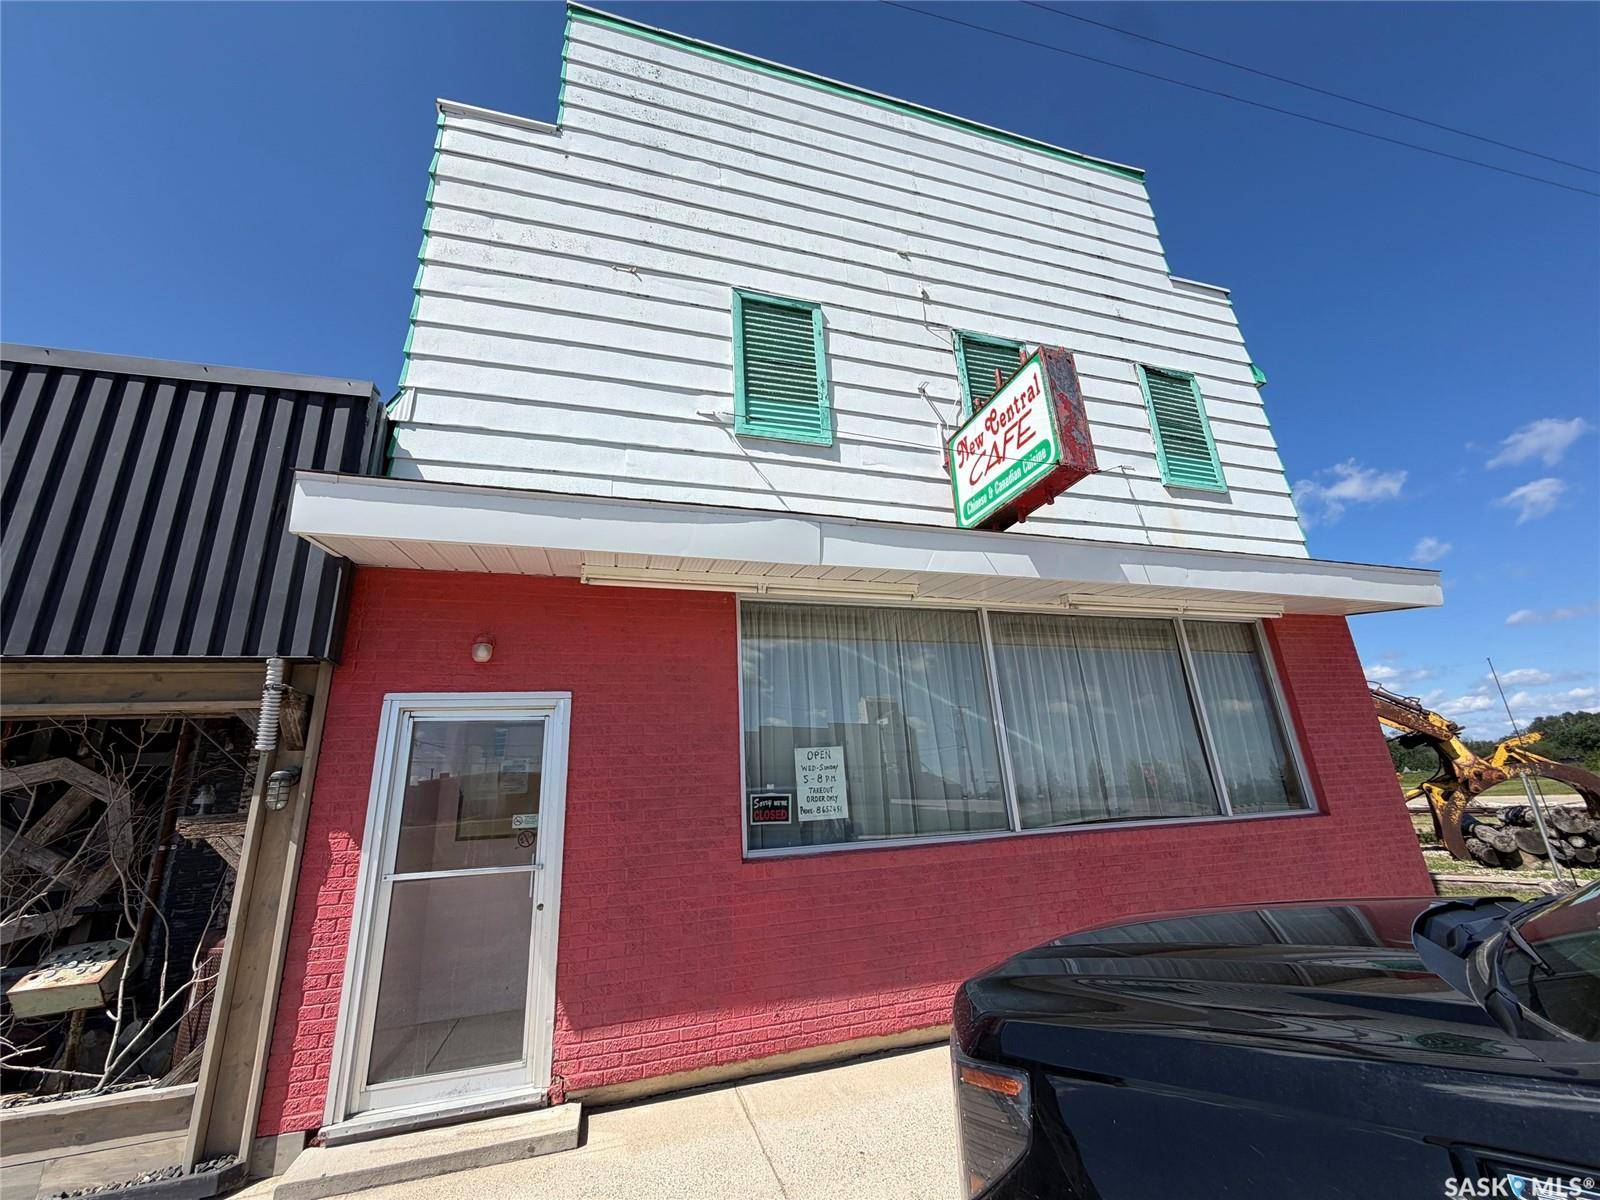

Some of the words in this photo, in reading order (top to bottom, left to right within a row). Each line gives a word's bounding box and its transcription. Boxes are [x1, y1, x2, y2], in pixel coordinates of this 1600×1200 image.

[957, 432, 984, 469] New
[985, 372, 1041, 435] Central
[969, 408, 1037, 486] CAFE
[966, 493, 988, 516] Chinese
[988, 486, 994, 499] &
[994, 467, 1022, 495] Canadian
[1022, 447, 1047, 474] Cuisine
[807, 750, 832, 761] OPEN
[808, 786, 834, 794] TAKEOUT
[753, 798, 773, 809] Sorry
[806, 795, 825, 803] ORDER
[826, 795, 838, 803] ONLY
[753, 809, 788, 820] CLOSED
